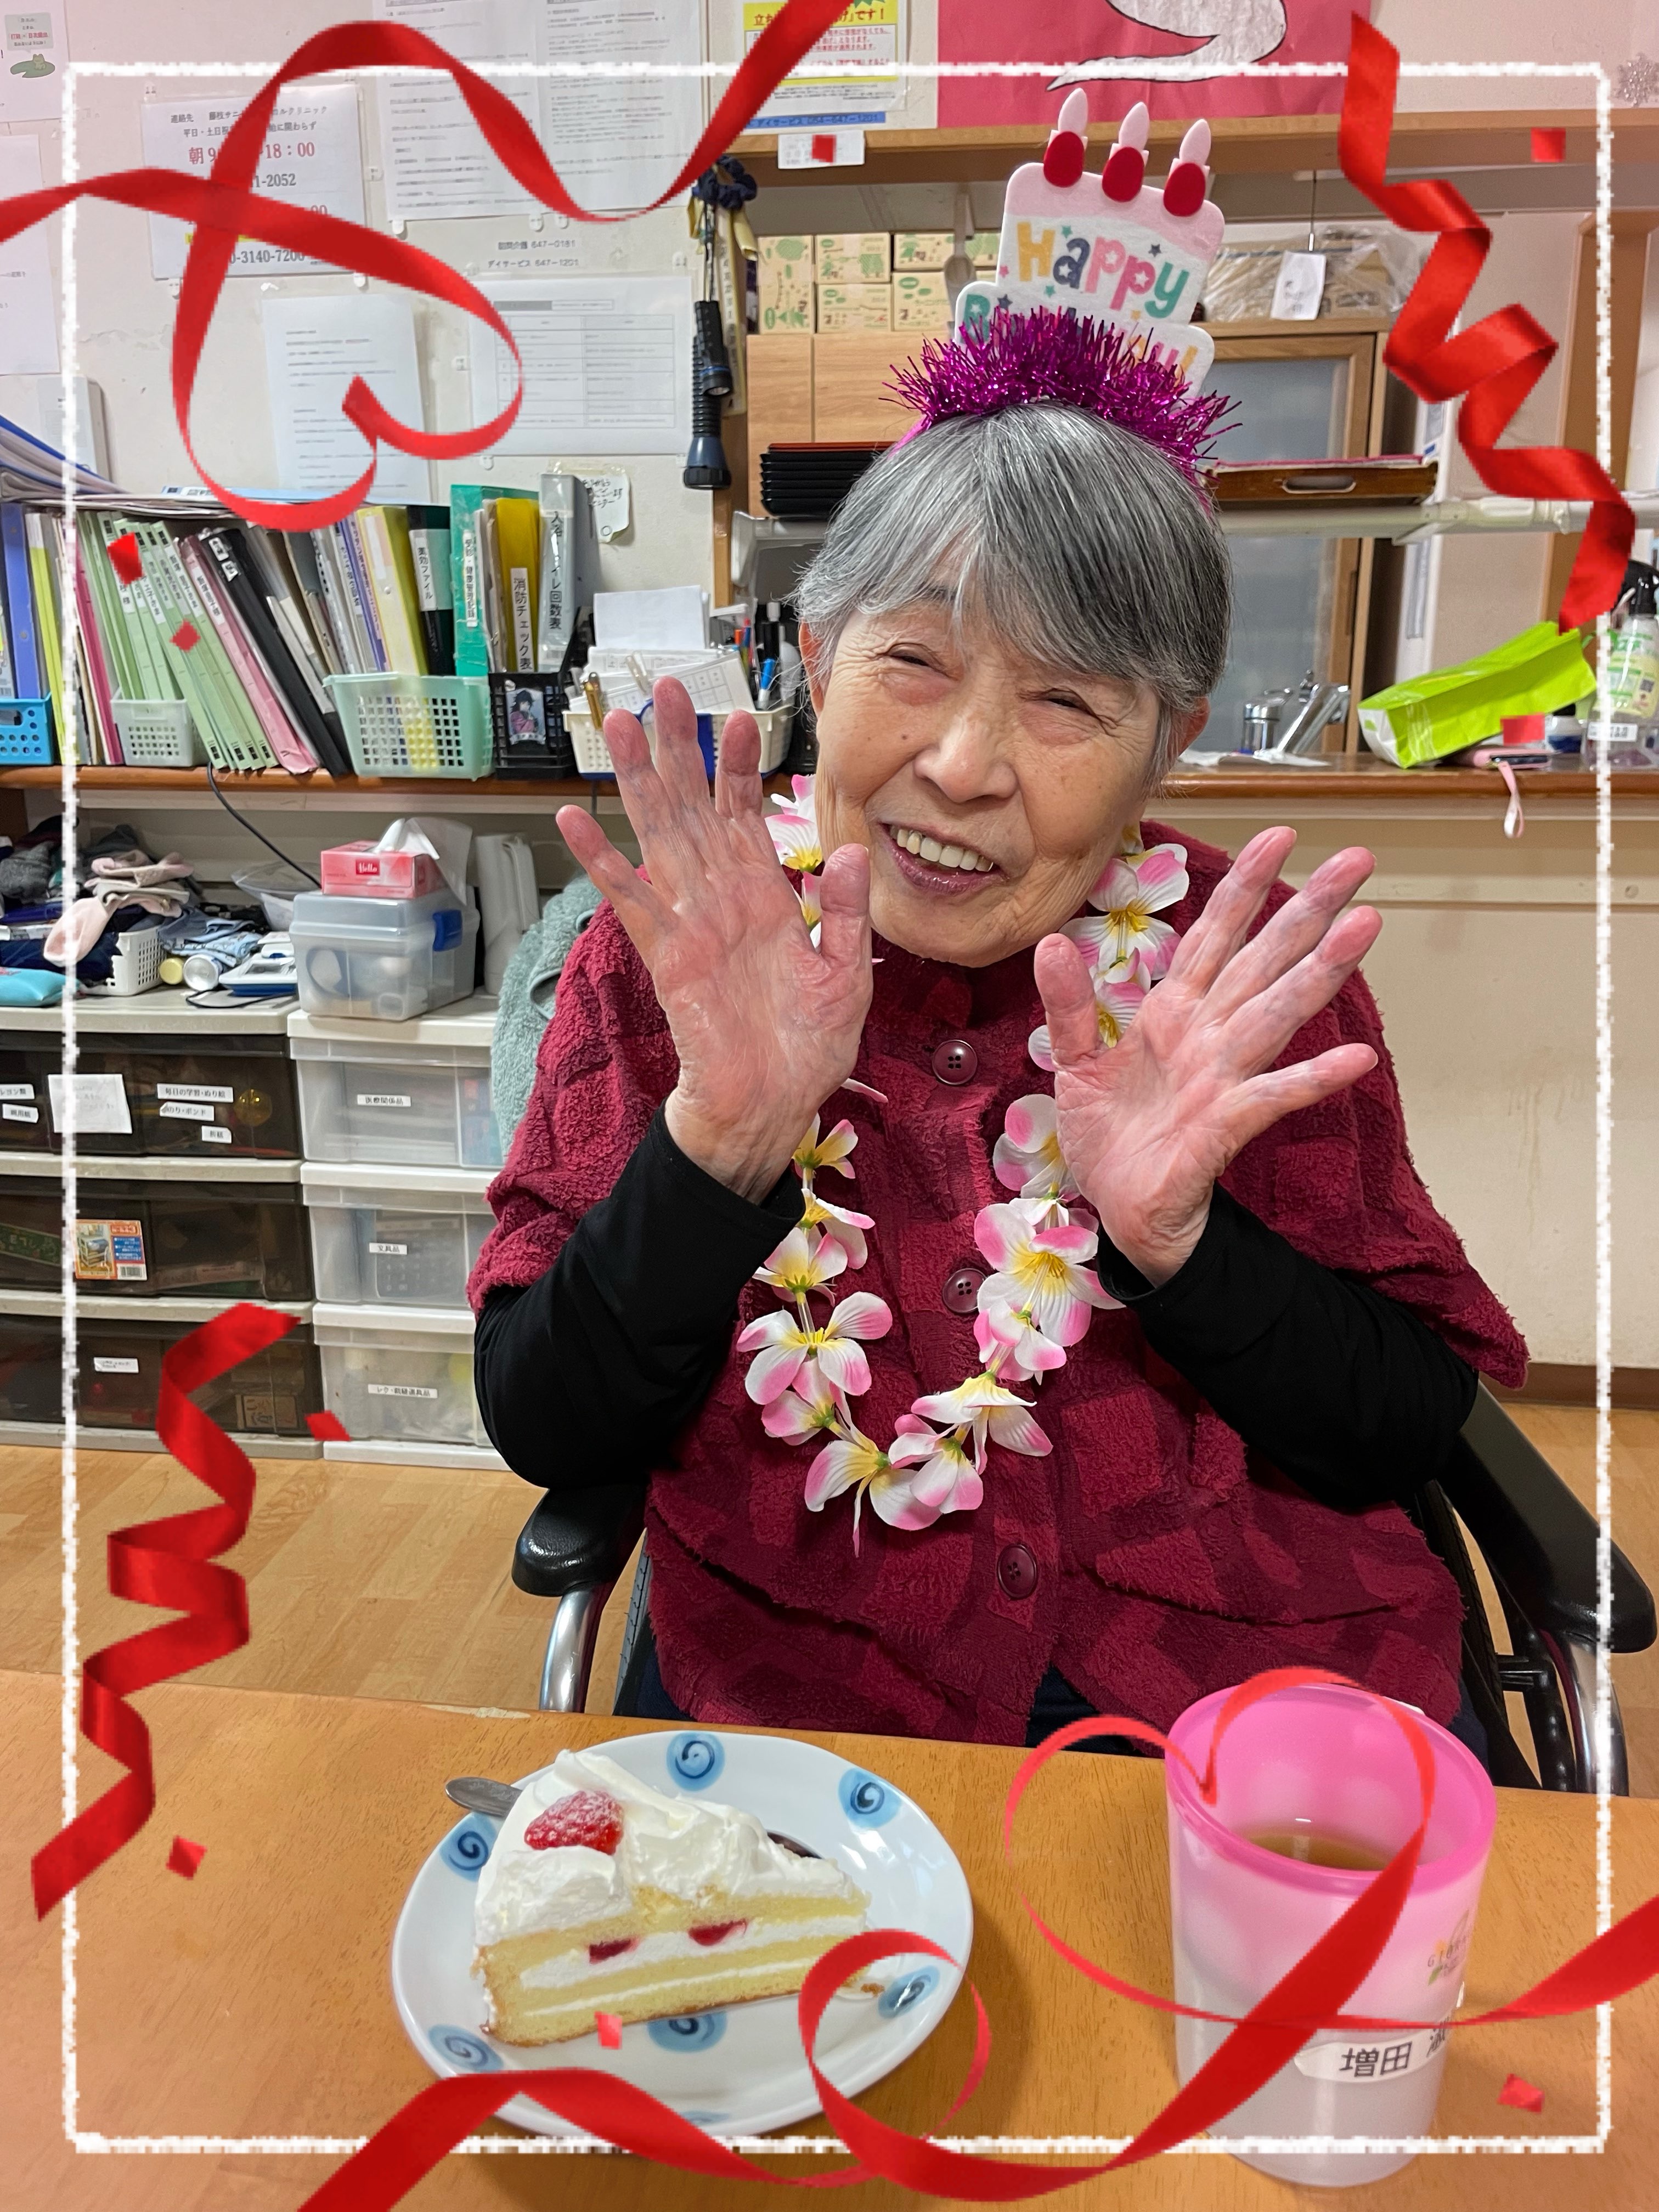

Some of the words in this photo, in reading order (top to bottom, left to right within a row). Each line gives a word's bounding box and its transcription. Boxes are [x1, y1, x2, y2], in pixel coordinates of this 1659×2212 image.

[1017, 221, 1189, 318] Happy
[514, 578, 533, 670] 消防チェック表
[358, 862, 377, 873] Hello
[1339, 2040, 1413, 2078] 増田
